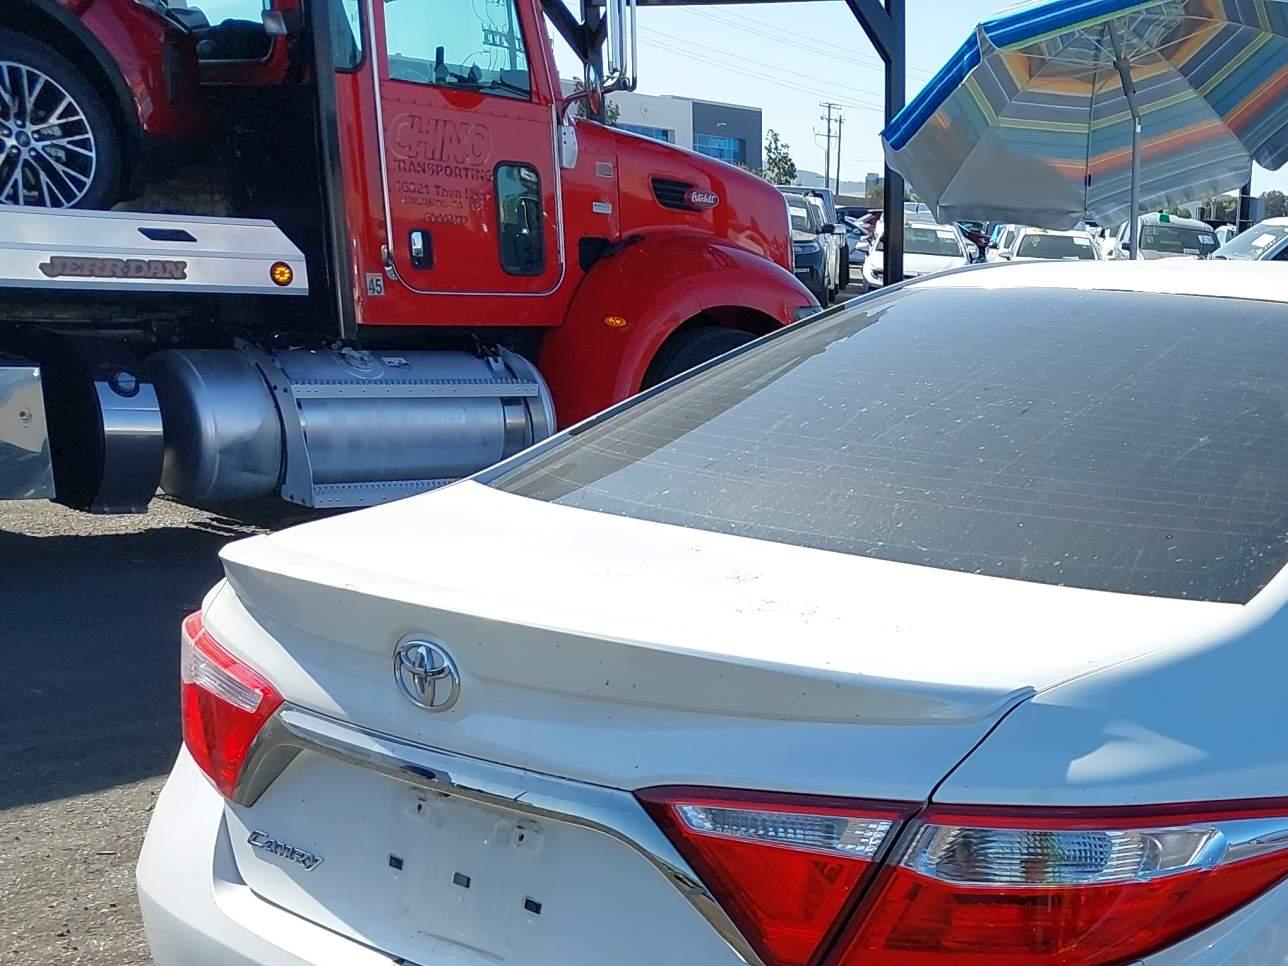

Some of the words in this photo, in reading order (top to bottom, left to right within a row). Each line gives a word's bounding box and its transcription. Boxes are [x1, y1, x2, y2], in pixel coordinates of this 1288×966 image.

[390, 113, 493, 167] CHINO
[393, 159, 494, 182] TRANSPORTING
[368, 278, 383, 294] 45
